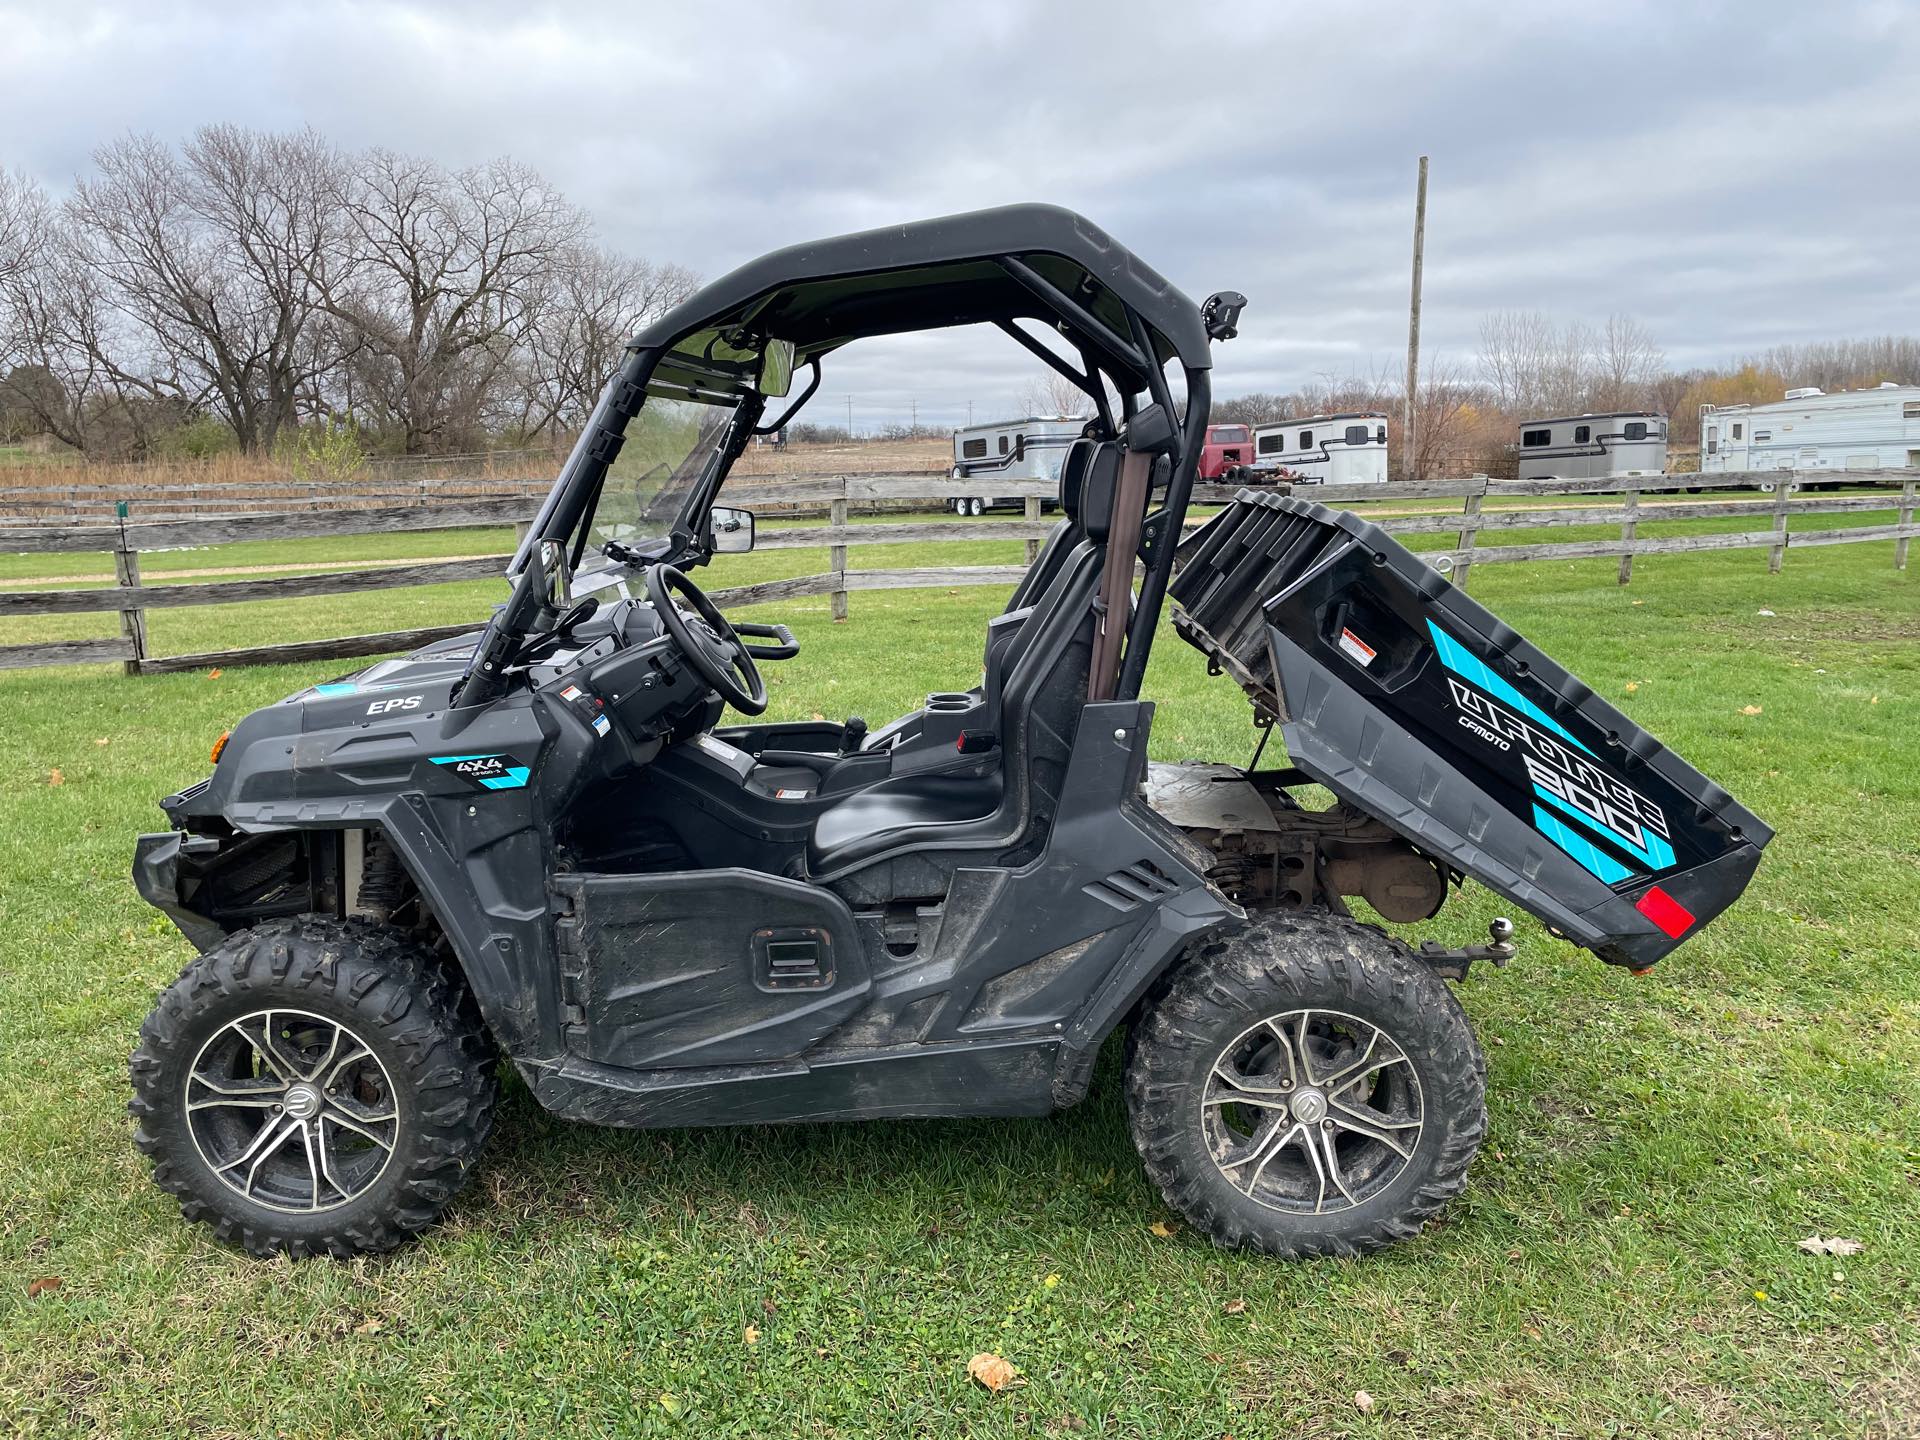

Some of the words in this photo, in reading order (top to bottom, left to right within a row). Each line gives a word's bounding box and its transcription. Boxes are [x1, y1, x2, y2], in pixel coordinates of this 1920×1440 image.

[366, 694, 424, 716] EPS
[1457, 715, 1512, 752] CFMOTO
[1521, 752, 1647, 851] 800
